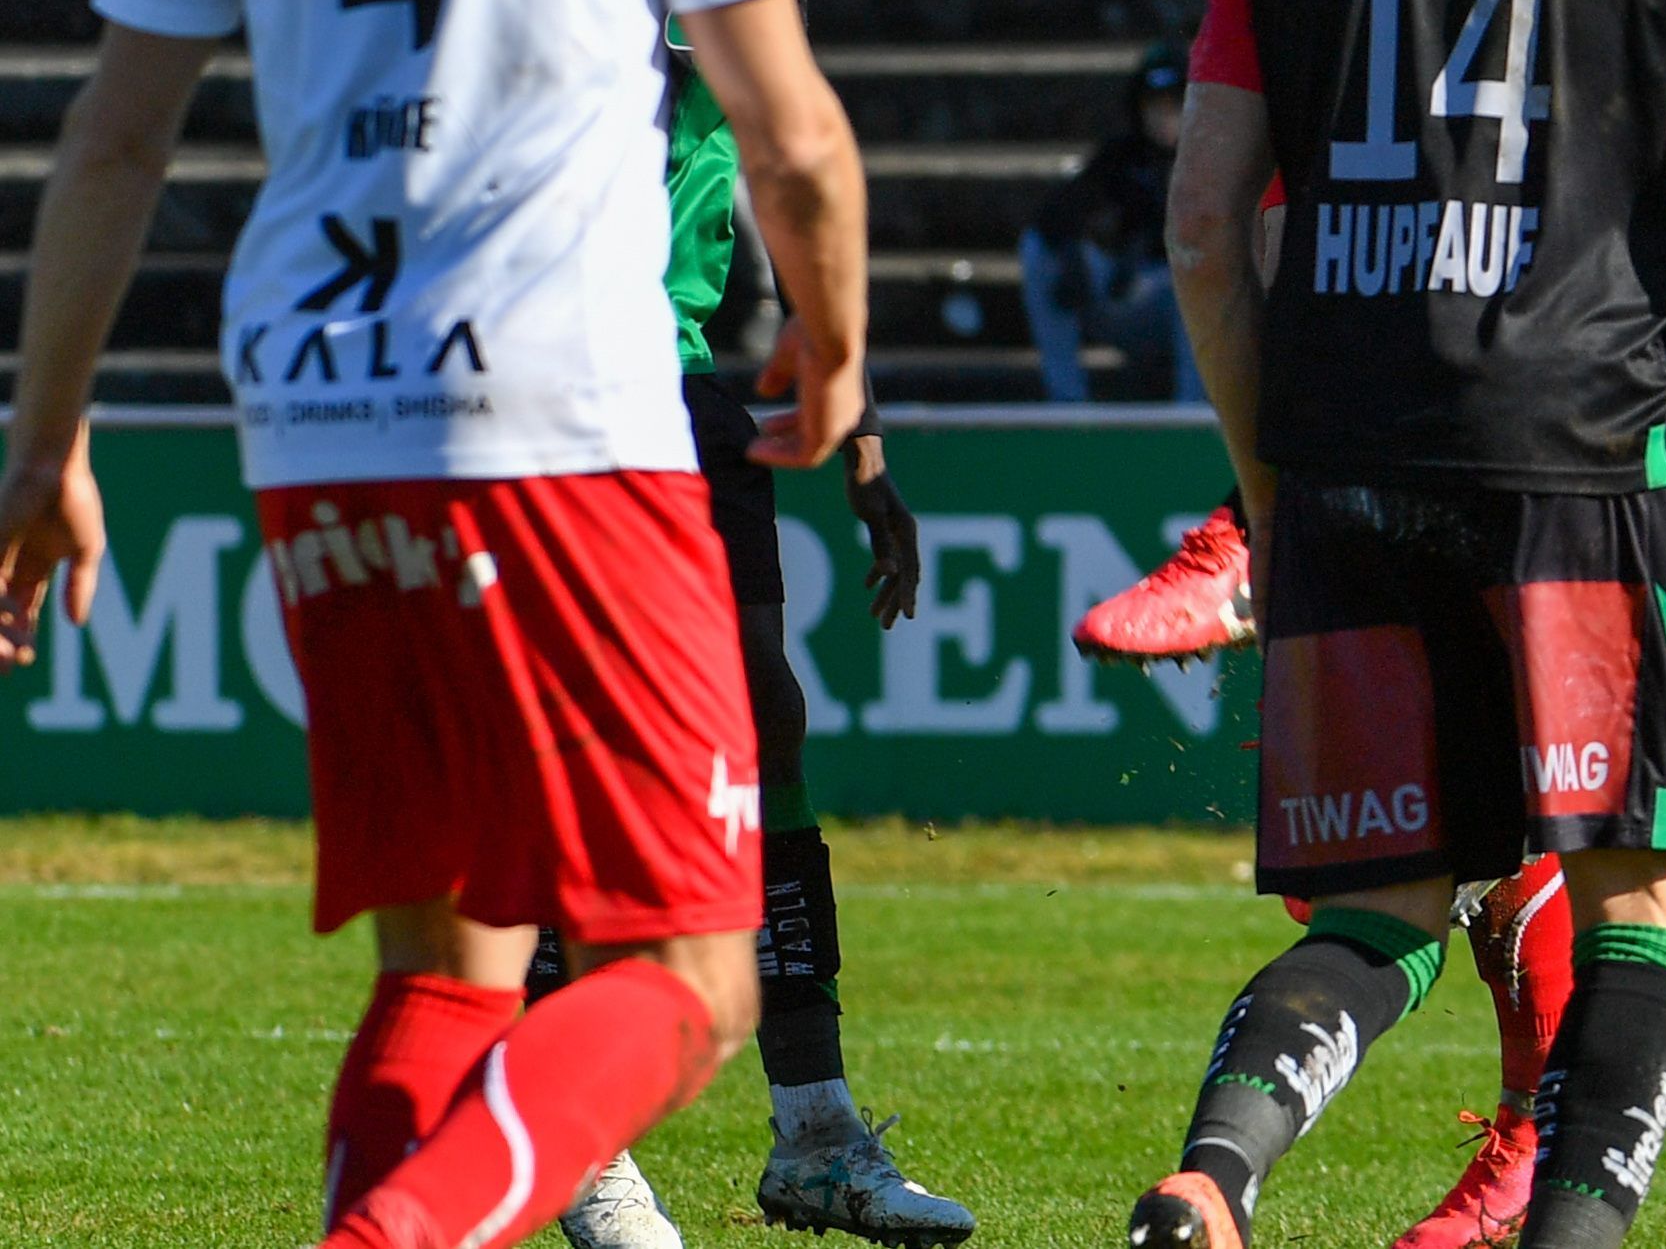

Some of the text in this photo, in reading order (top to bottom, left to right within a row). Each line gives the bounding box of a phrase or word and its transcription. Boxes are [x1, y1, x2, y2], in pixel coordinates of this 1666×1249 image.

[1313, 198, 1541, 298] HUPFAUF
[238, 317, 486, 384] KALA
[1280, 782, 1430, 846] TIWAG
